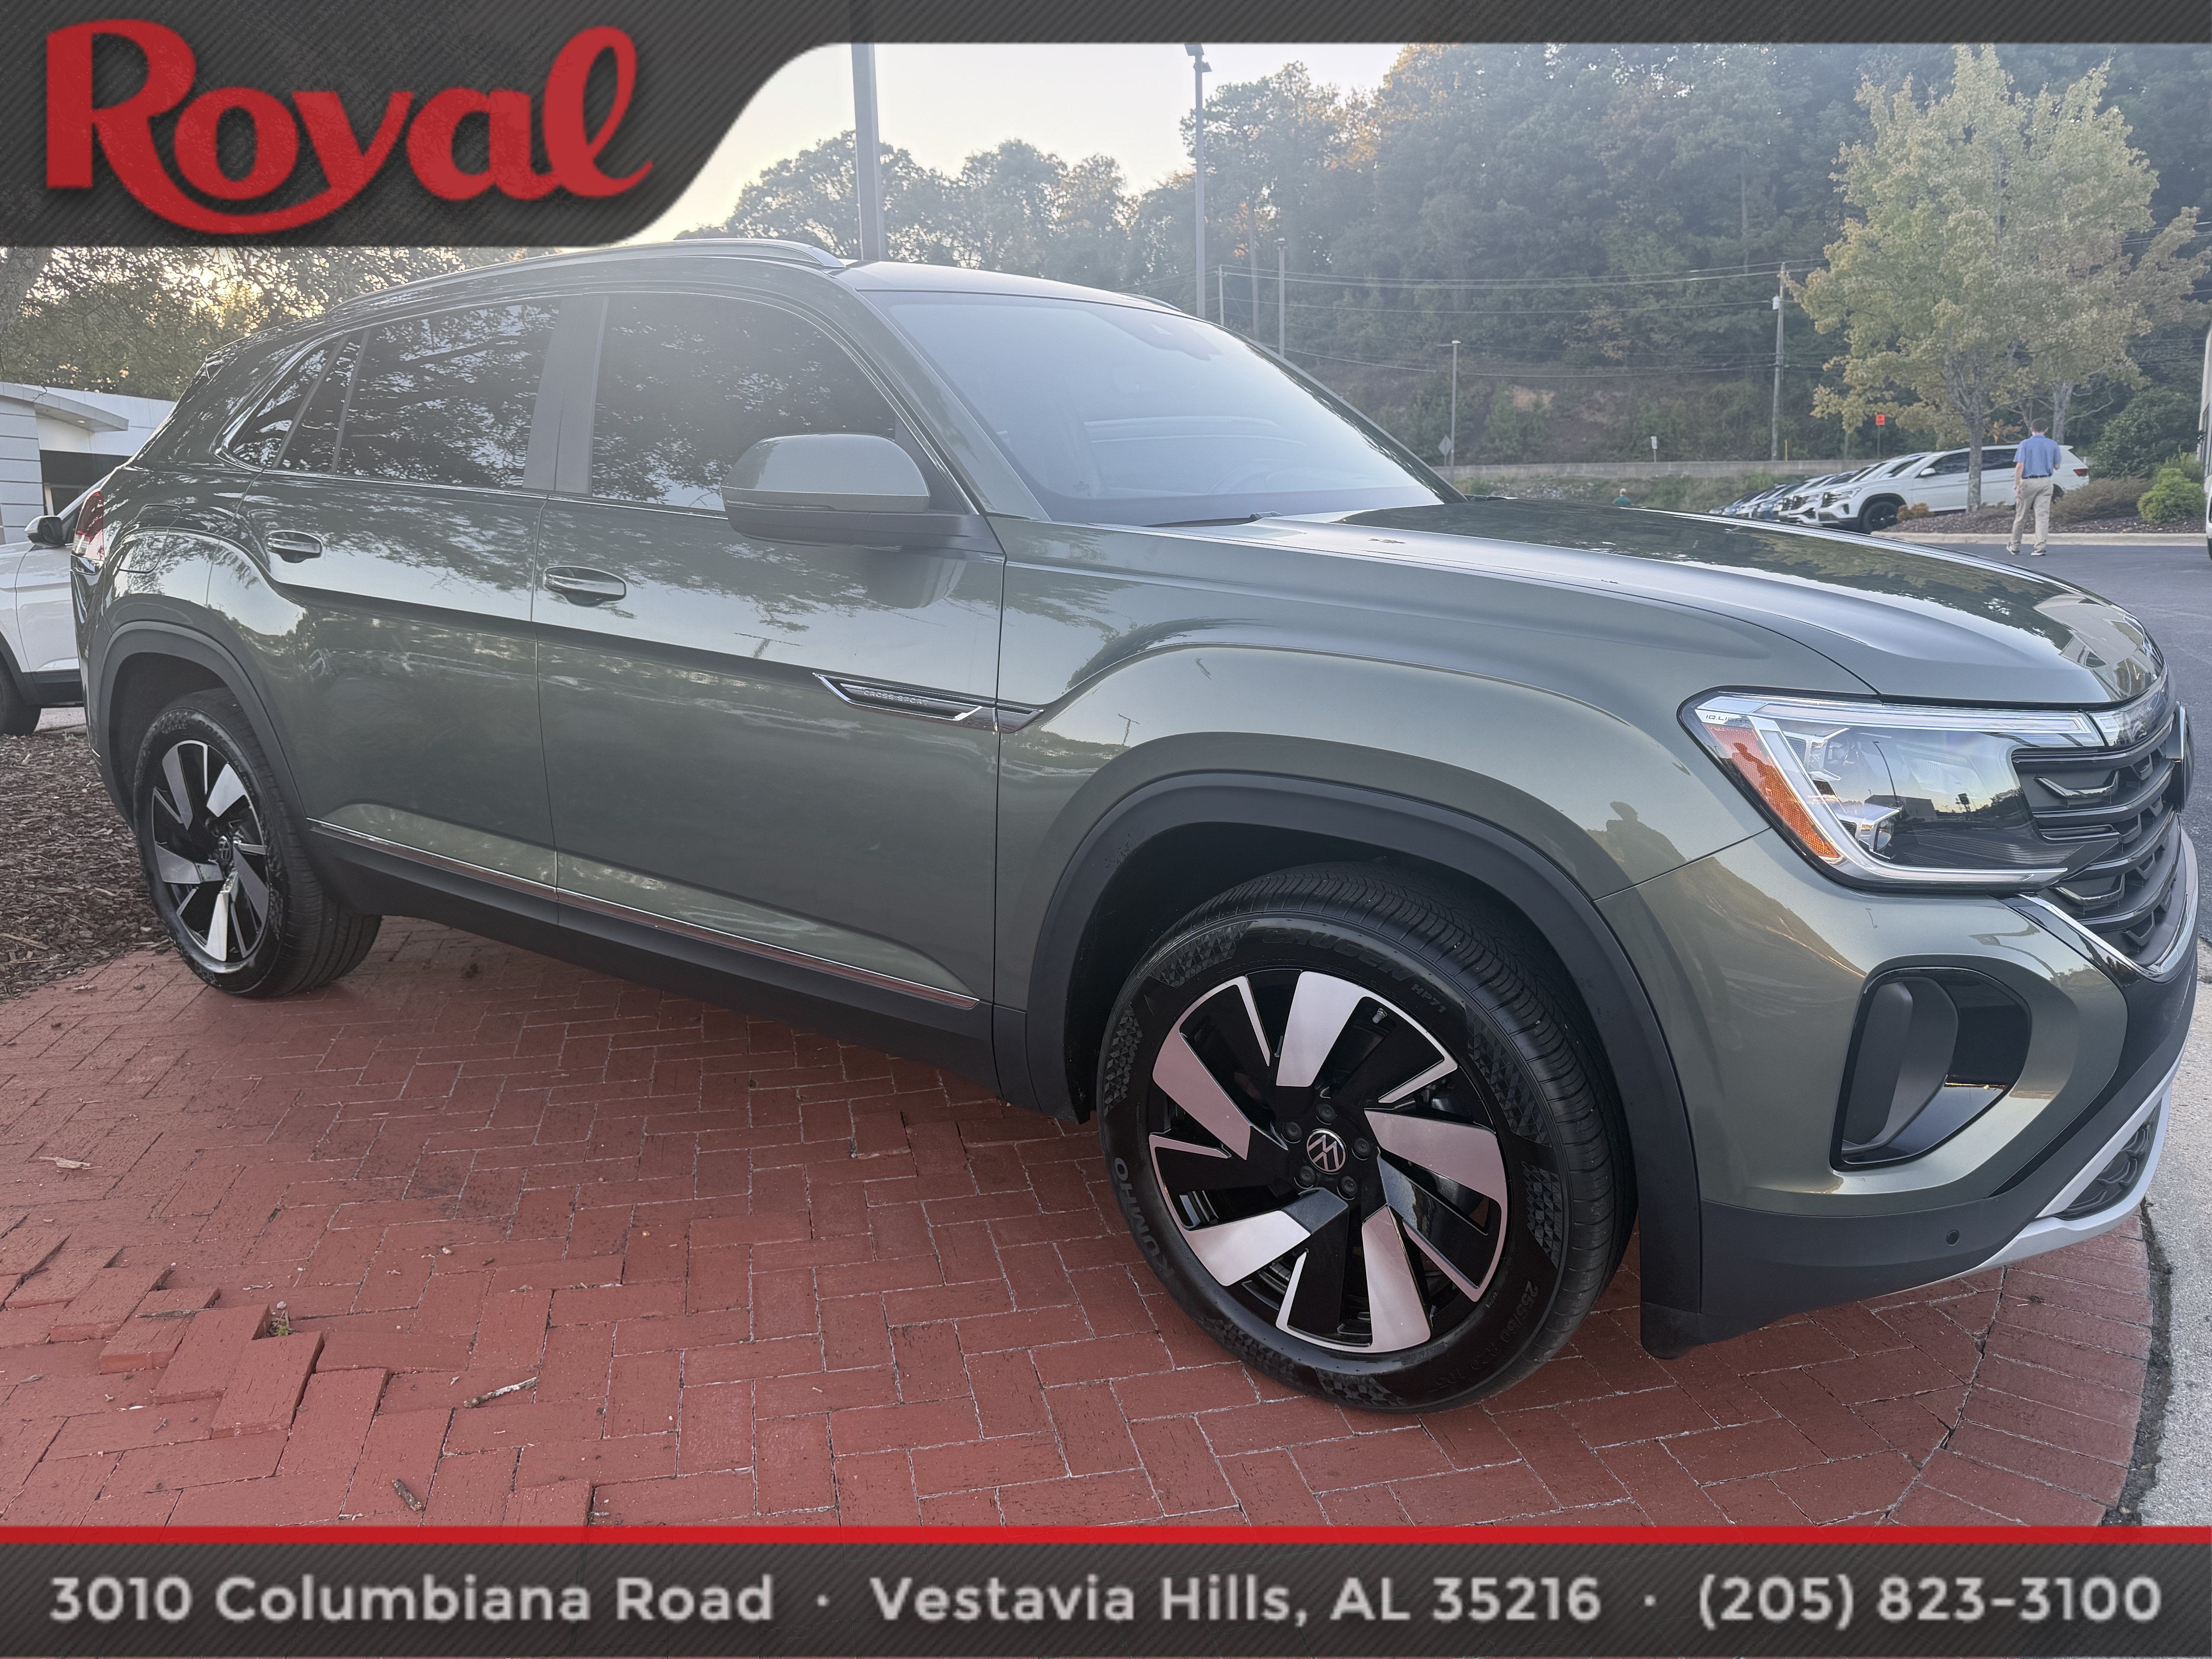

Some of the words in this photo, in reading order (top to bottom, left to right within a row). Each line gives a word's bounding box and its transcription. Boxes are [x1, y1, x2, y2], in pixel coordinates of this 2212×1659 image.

[864, 690, 894, 700] CROSS
[898, 696, 928, 705] SPORT
[1706, 715, 1749, 723] IQ.LIGHT
[1262, 928, 1419, 981] CRUGEN
[1411, 984, 1446, 1013] HP71
